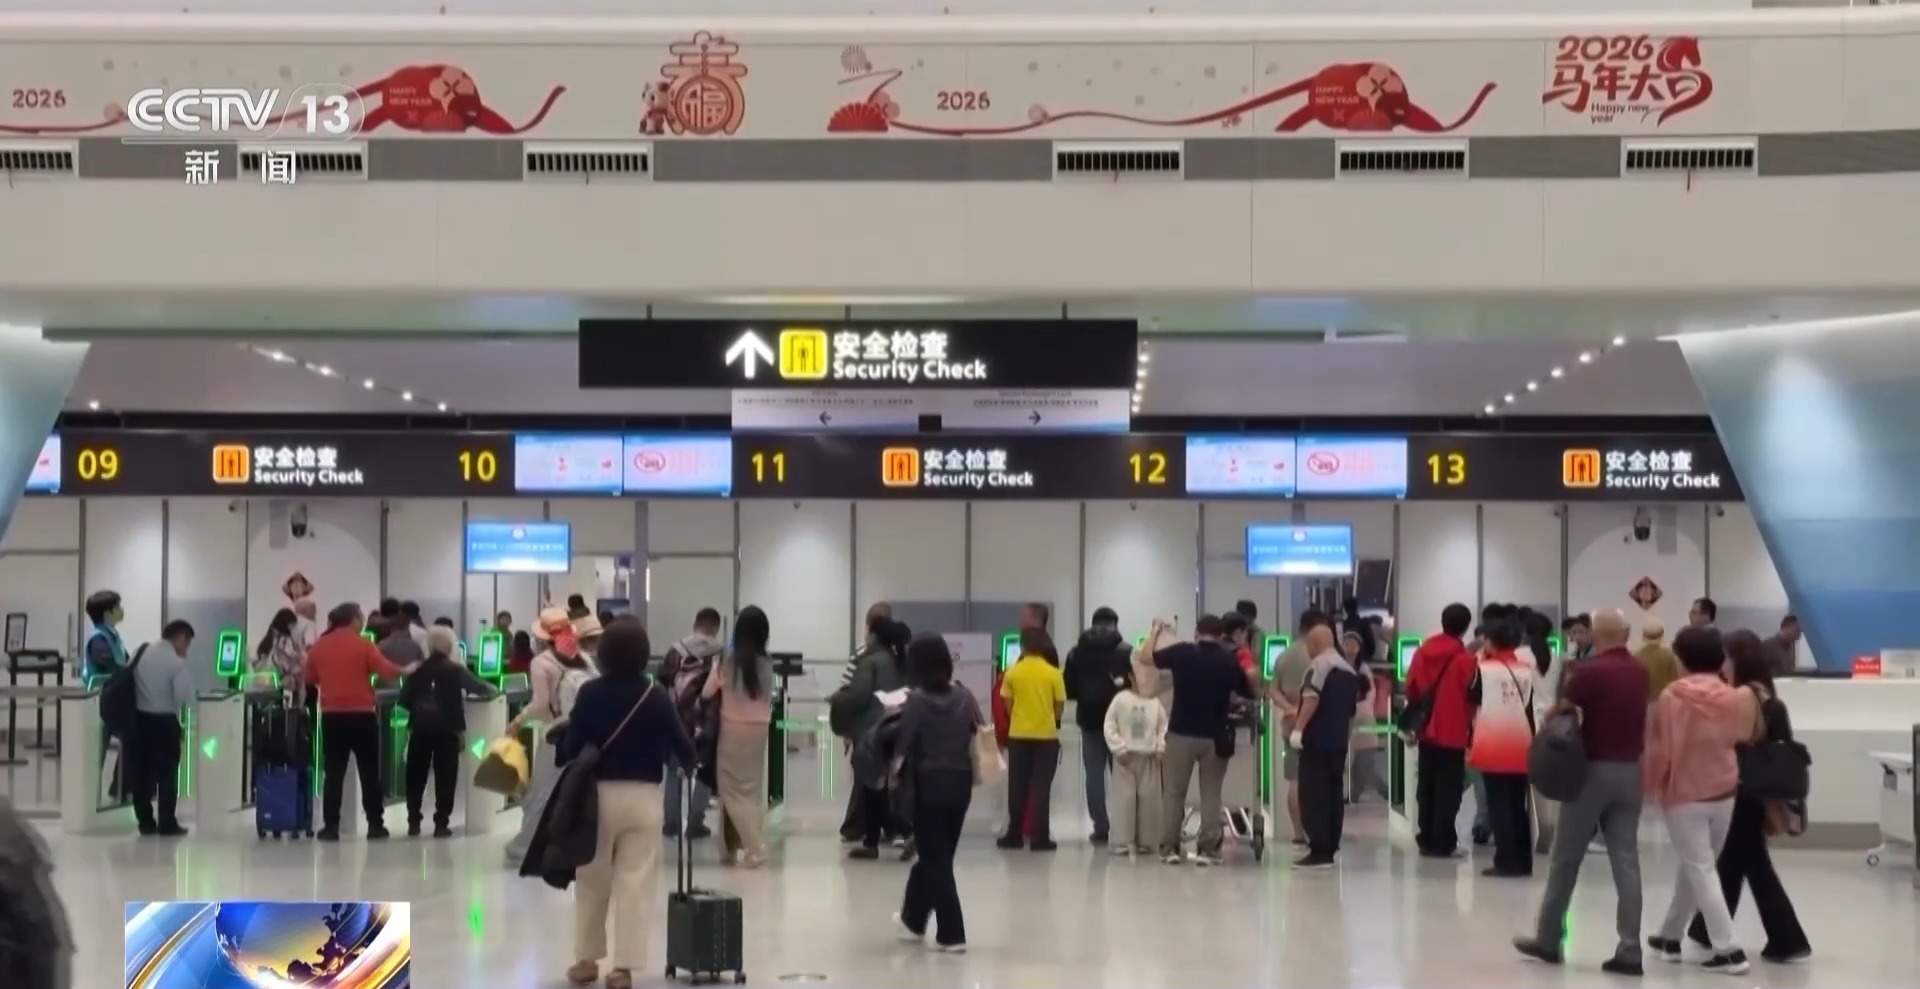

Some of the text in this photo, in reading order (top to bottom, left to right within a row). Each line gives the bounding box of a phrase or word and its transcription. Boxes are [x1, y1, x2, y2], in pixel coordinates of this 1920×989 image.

[1556, 35, 1653, 61] 2026
[1591, 102, 1626, 115] Happy
[1591, 115, 1613, 125] year
[832, 330, 948, 360] 安全检查
[833, 359, 987, 383] Security Check
[78, 449, 118, 480] 09
[253, 446, 338, 469] 安全检查
[459, 451, 496, 481] 10
[752, 453, 784, 482] 11
[923, 449, 1007, 471] 安全检查
[1129, 453, 1166, 483] 12
[1428, 454, 1465, 484] 13
[1605, 450, 1692, 472] 安全检查
[254, 467, 364, 486] Security Check
[923, 470, 1033, 488] Security Check
[1606, 471, 1720, 490] Security Check
